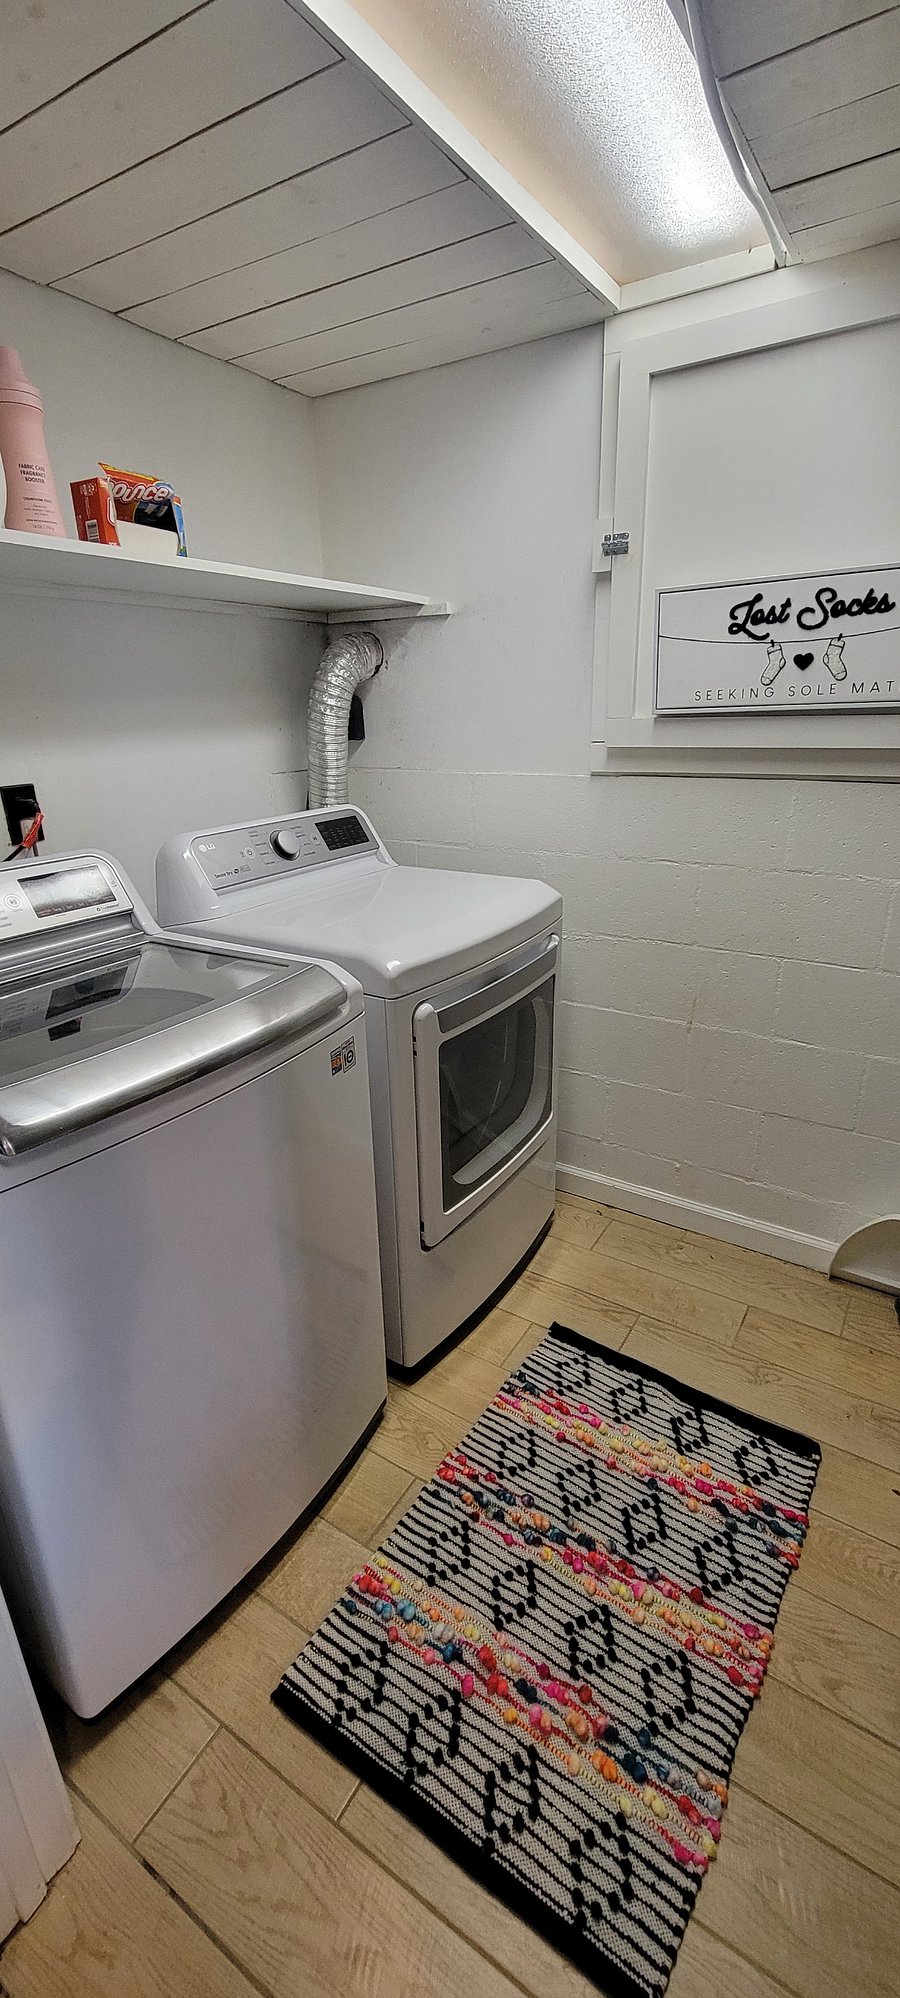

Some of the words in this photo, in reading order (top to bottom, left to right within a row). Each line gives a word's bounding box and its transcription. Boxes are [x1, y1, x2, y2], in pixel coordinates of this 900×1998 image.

[112, 482, 169, 502] ounce
[728, 593, 792, 641] Lost
[796, 587, 896, 631] Socks
[694, 686, 775, 702] SEEKING
[788, 682, 838, 697] SOLE
